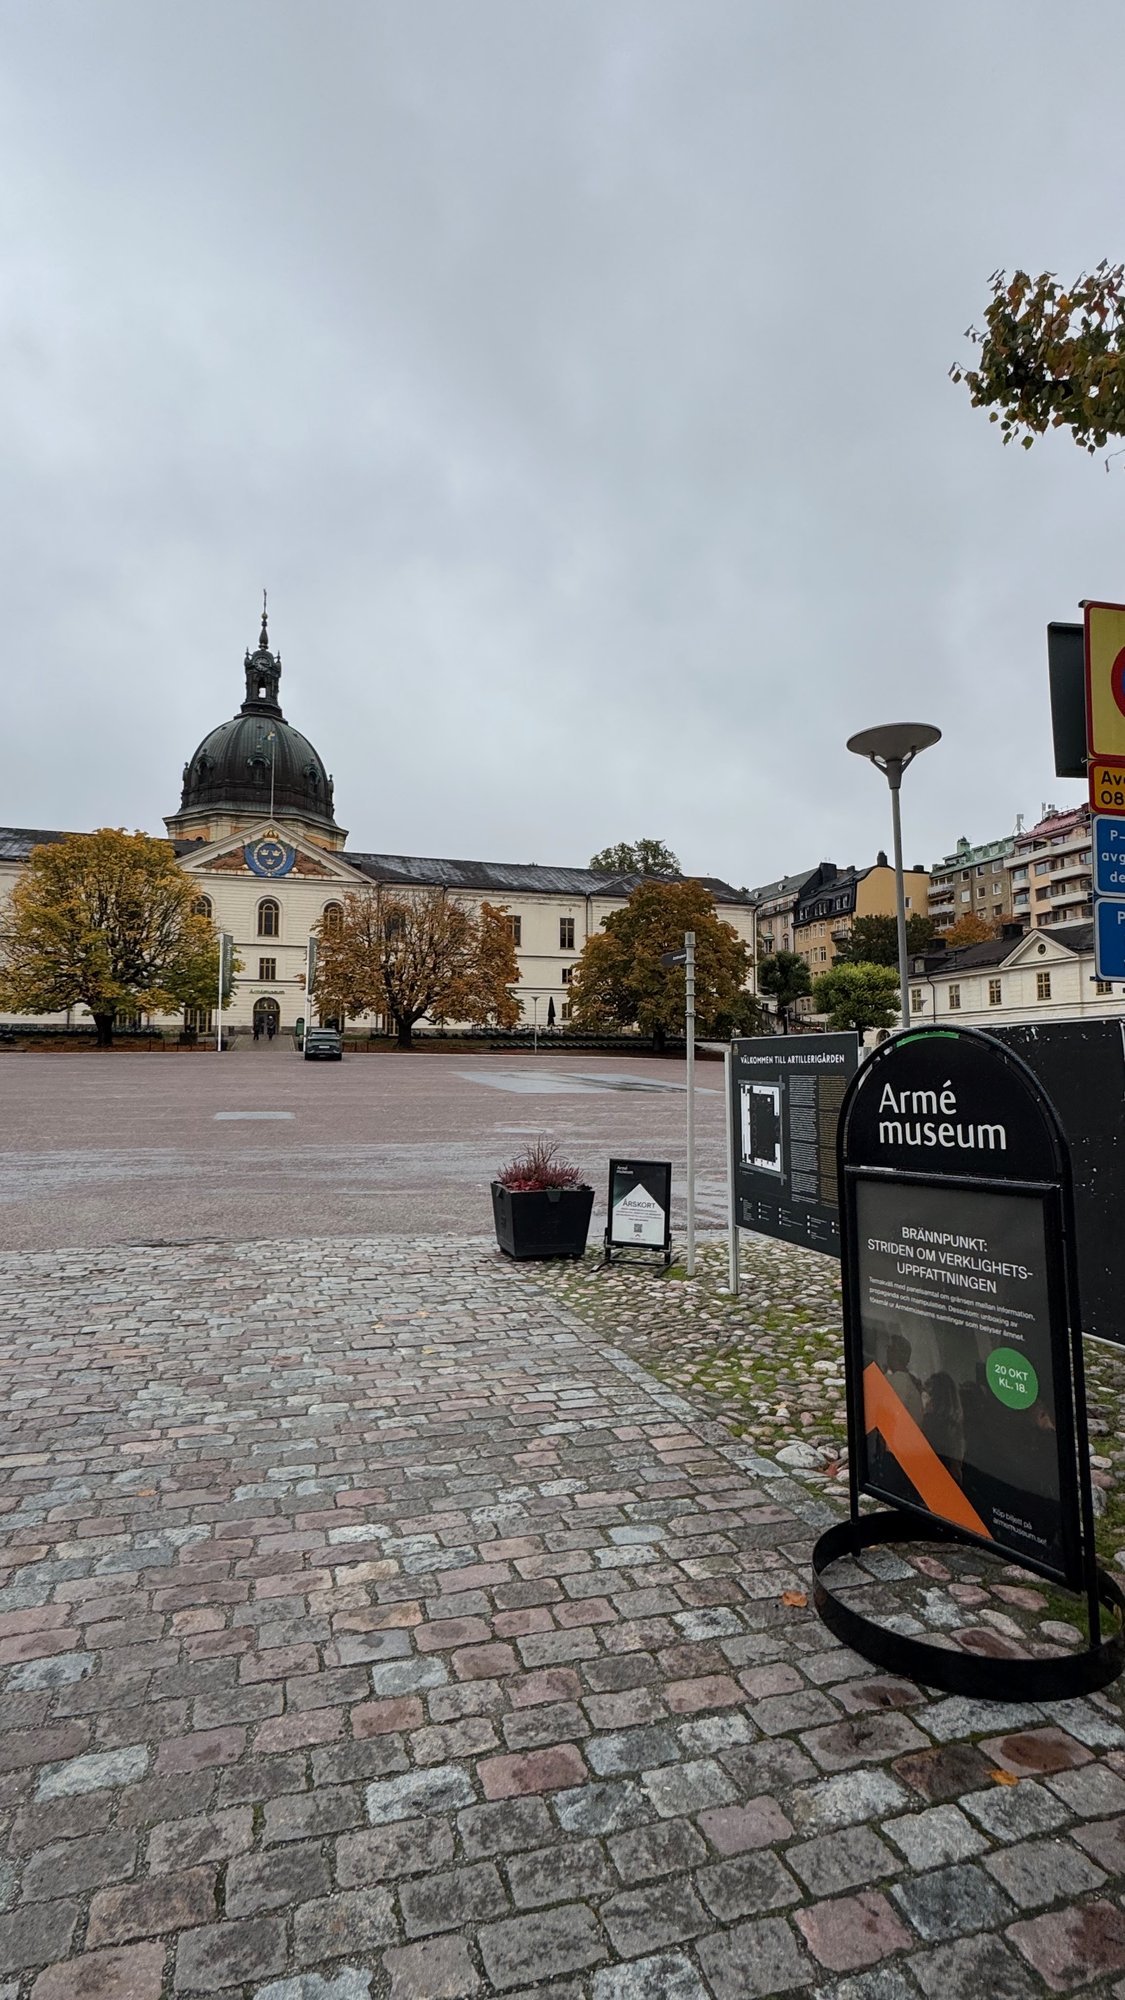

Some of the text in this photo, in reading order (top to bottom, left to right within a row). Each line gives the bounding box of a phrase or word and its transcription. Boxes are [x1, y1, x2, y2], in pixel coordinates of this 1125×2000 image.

[1101, 770, 1125, 786] Av
[740, 1052, 844, 1064] VÄLKOMMEN TILL ARTILLERIGÅRDEN
[879, 1080, 957, 1115] Armé
[879, 1120, 1006, 1150] museum
[622, 1198, 656, 1208] ÅRSKORT
[902, 1226, 988, 1253] BRÄNNPUNKT:
[868, 1238, 1034, 1280] STRIDEN OM VERKLIGHETS-
[896, 1262, 998, 1294] UPPFATTNINGEN
[994, 1364, 1028, 1381] 20 OKT
[998, 1377, 1028, 1394] KL. 18.
